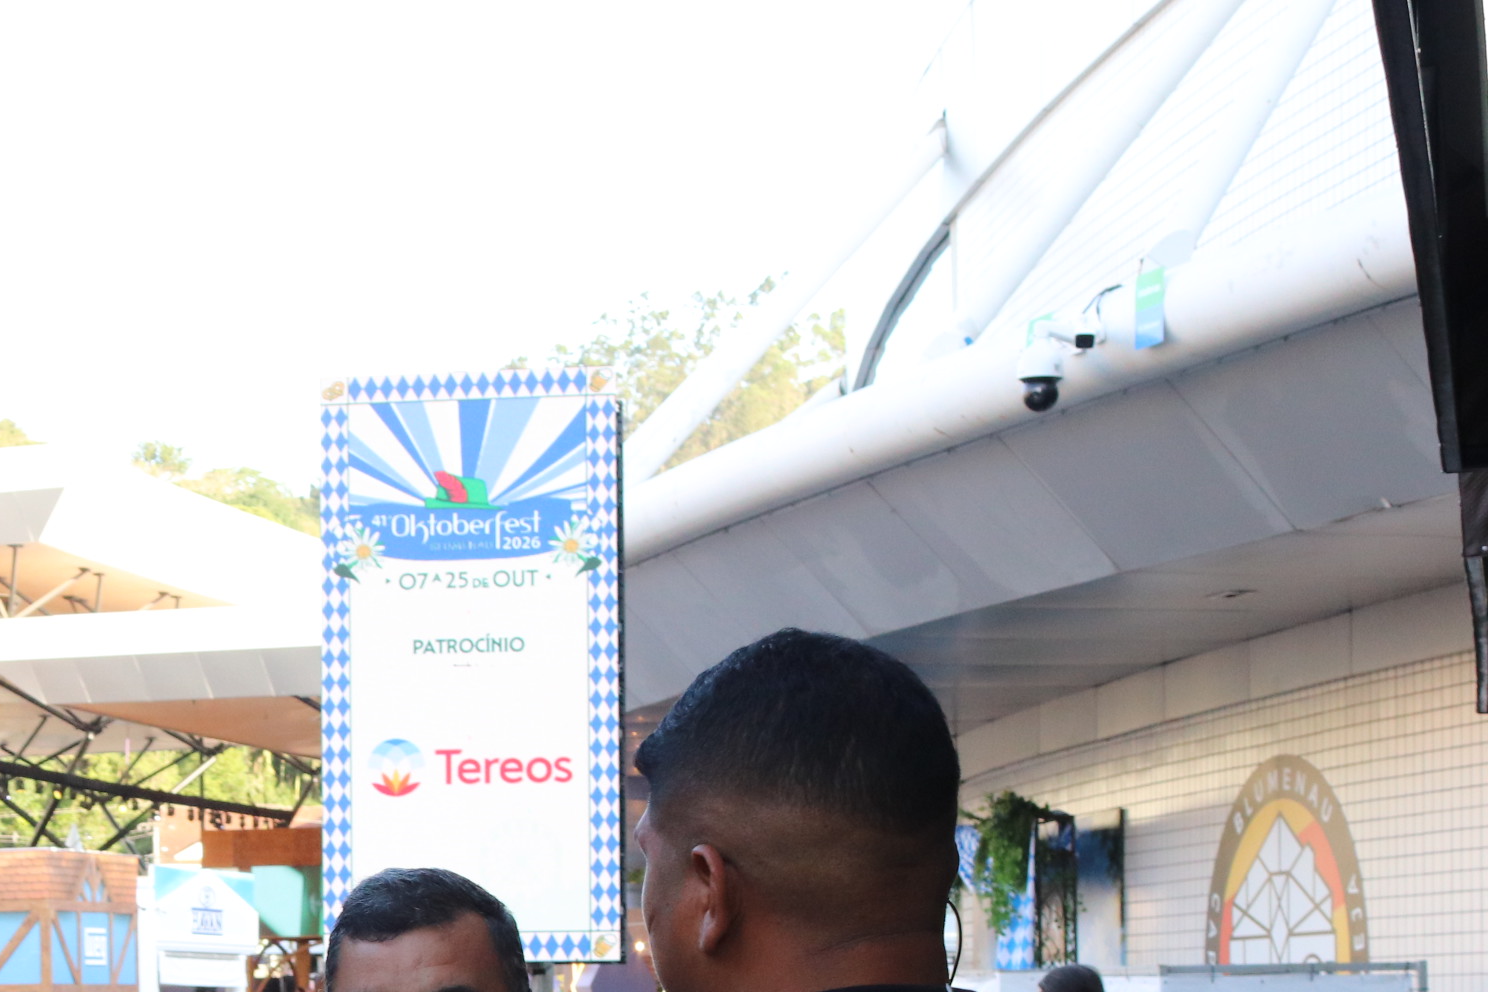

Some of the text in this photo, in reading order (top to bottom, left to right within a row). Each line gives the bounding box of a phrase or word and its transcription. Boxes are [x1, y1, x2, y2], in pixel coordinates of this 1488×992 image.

[391, 510, 542, 549] Oktoberfest
[502, 535, 541, 550] 2026
[446, 571, 469, 588] 25
[493, 570, 539, 588] OUT
[413, 633, 526, 655] PATROCÍNIO
[434, 748, 574, 785] Tereos
